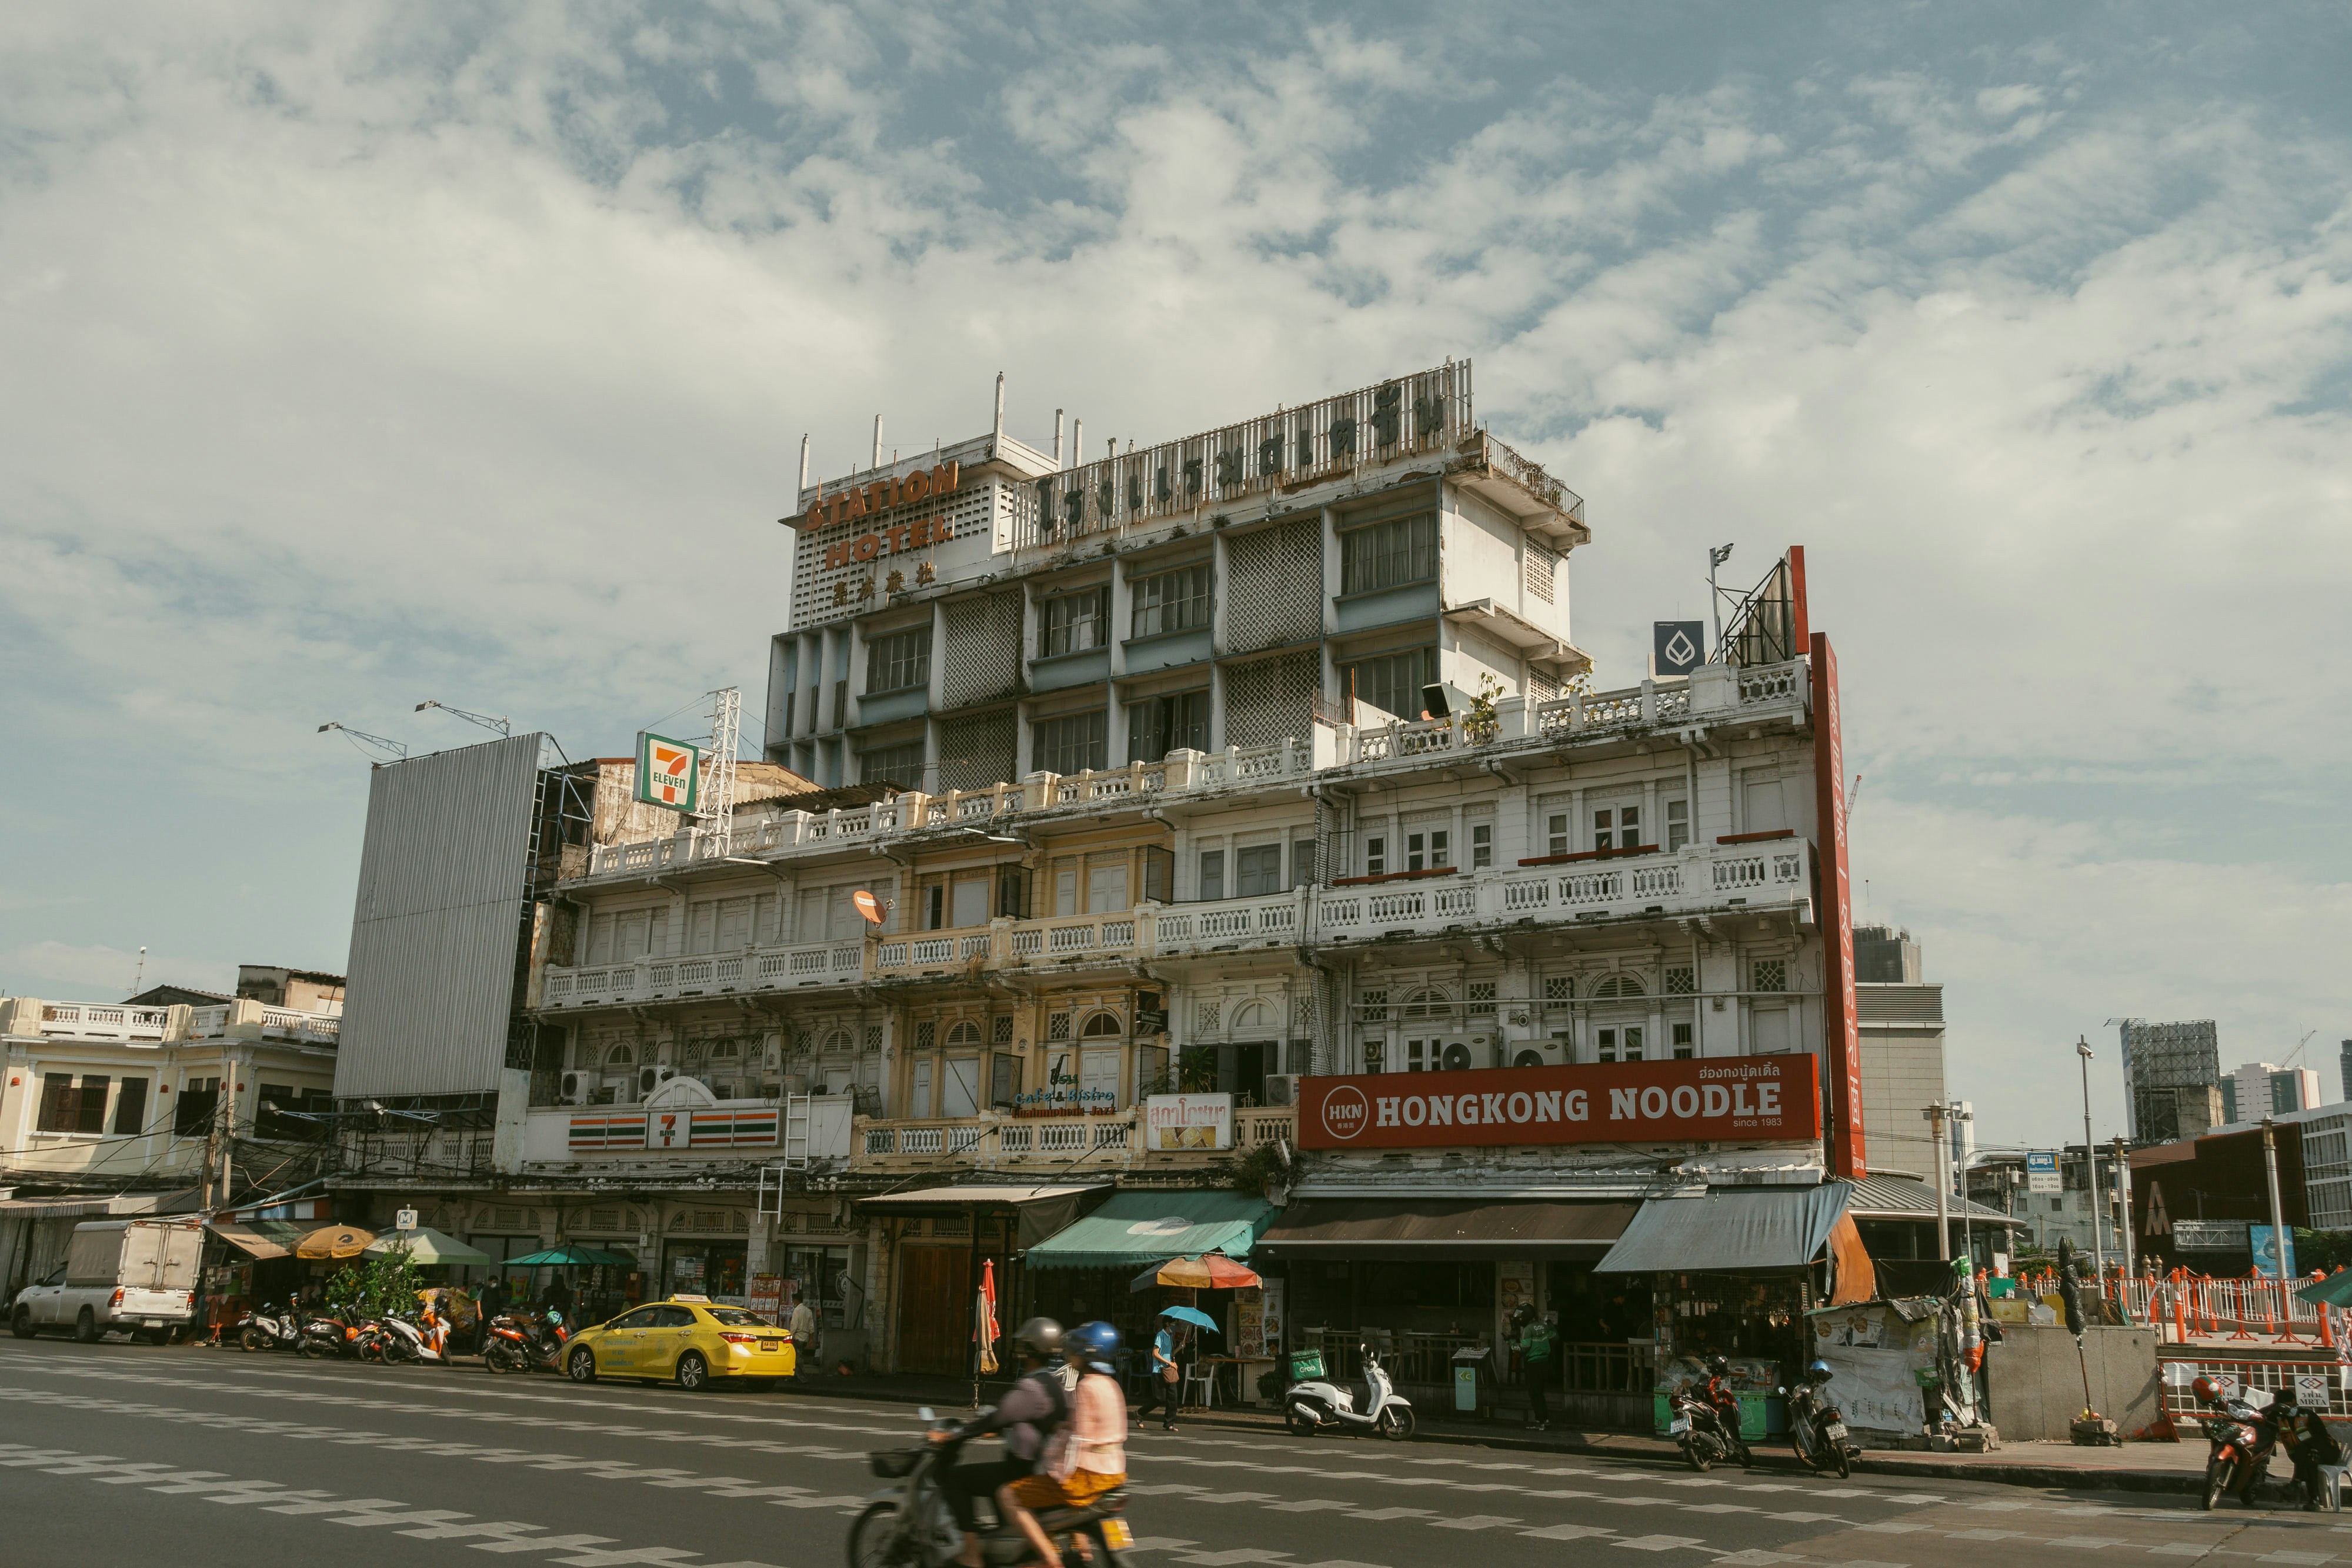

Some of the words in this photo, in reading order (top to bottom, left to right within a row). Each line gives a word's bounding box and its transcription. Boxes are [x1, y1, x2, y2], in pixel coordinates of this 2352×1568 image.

[806, 461, 958, 531] STATION
[825, 515, 954, 571] HOTEL
[832, 561, 936, 608] 集成旅社
[656, 746, 688, 803] 7
[1829, 686, 1860, 1128] 泰国第一冬阴功面
[1055, 1091, 1065, 1102] &
[1067, 1087, 1114, 1102] Bistro
[1090, 1105, 1116, 1116] Jazz
[1329, 1104, 1362, 1120] HKN
[1376, 1089, 1588, 1127] HONGKONG
[1609, 1082, 1781, 1120] NOODLE
[660, 1115, 676, 1146] 7
[1733, 1118, 1757, 1127] since
[1761, 1117, 1782, 1126] 1983
[1299, 1365, 1316, 1373] Grab
